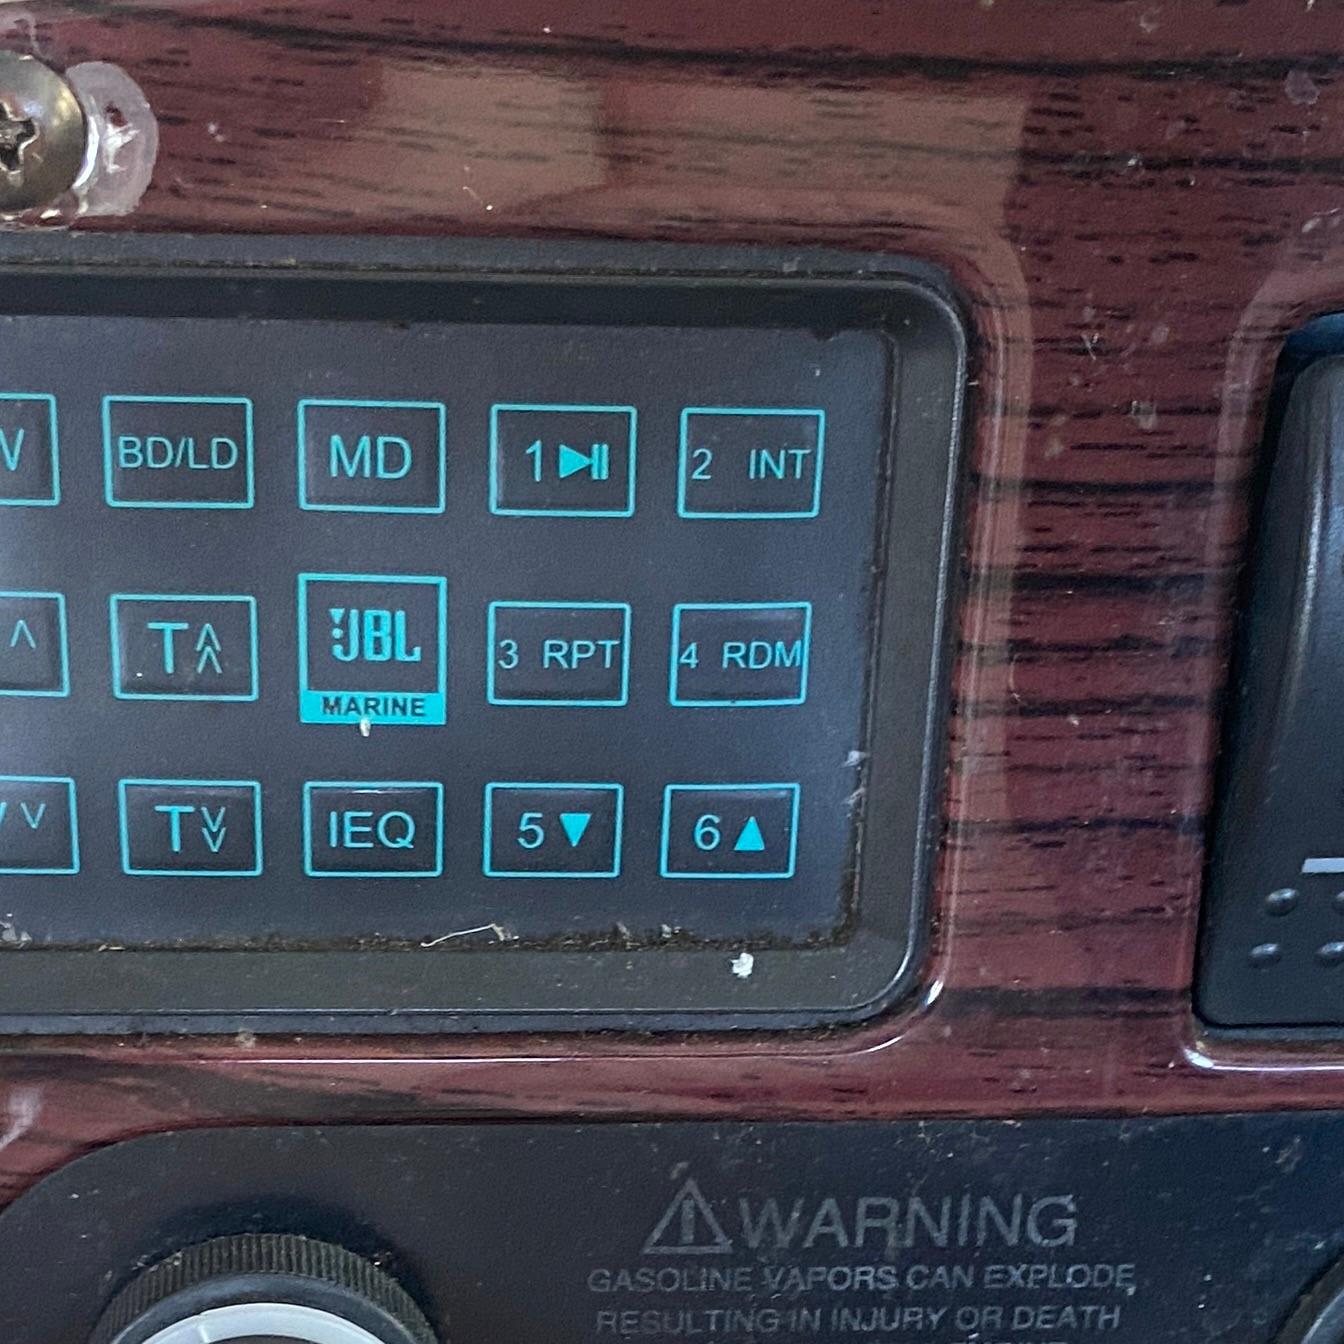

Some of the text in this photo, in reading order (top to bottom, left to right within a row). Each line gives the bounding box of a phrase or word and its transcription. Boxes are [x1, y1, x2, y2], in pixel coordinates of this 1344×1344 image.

[117, 435, 239, 470] BD/LD
[329, 434, 413, 480] MD
[690, 446, 812, 481] 2 INT
[329, 607, 422, 662] JBL
[497, 638, 619, 671] 3 RPT
[678, 639, 804, 672] 4 RDM
[321, 695, 426, 717] MARINE
[328, 809, 416, 850] IEQ
[516, 810, 544, 851] 5
[692, 812, 721, 853] 6
[738, 1194, 1077, 1250] WARNING
[587, 1266, 753, 1292] GASOLINE
[763, 1265, 899, 1291] VAPORS
[906, 1264, 974, 1290] CAN
[596, 1304, 1121, 1335] RESULTING IN INJURY OR DEATH
